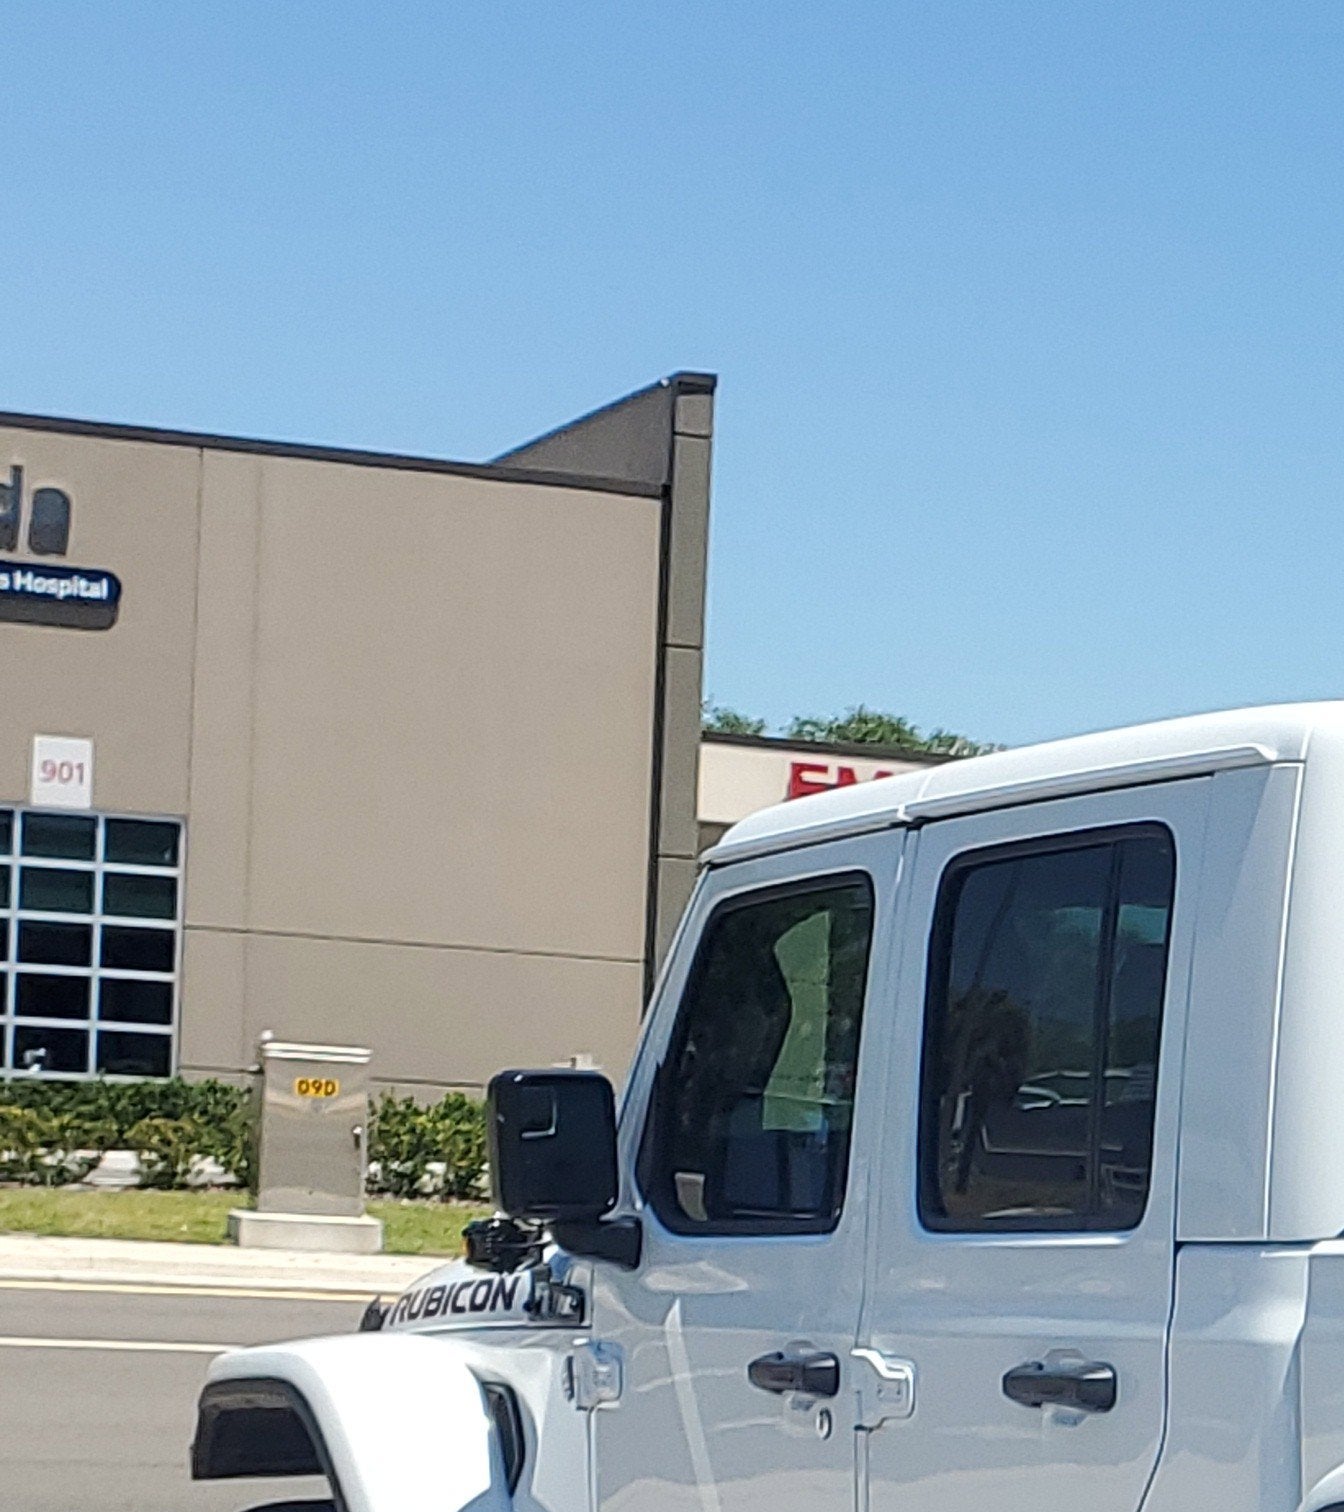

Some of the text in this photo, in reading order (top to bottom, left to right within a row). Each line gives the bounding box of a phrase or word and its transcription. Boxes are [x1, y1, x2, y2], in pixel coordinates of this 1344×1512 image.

[12, 569, 109, 600] Hospital
[40, 759, 85, 785] 901
[389, 1274, 521, 1326] RUBICON
